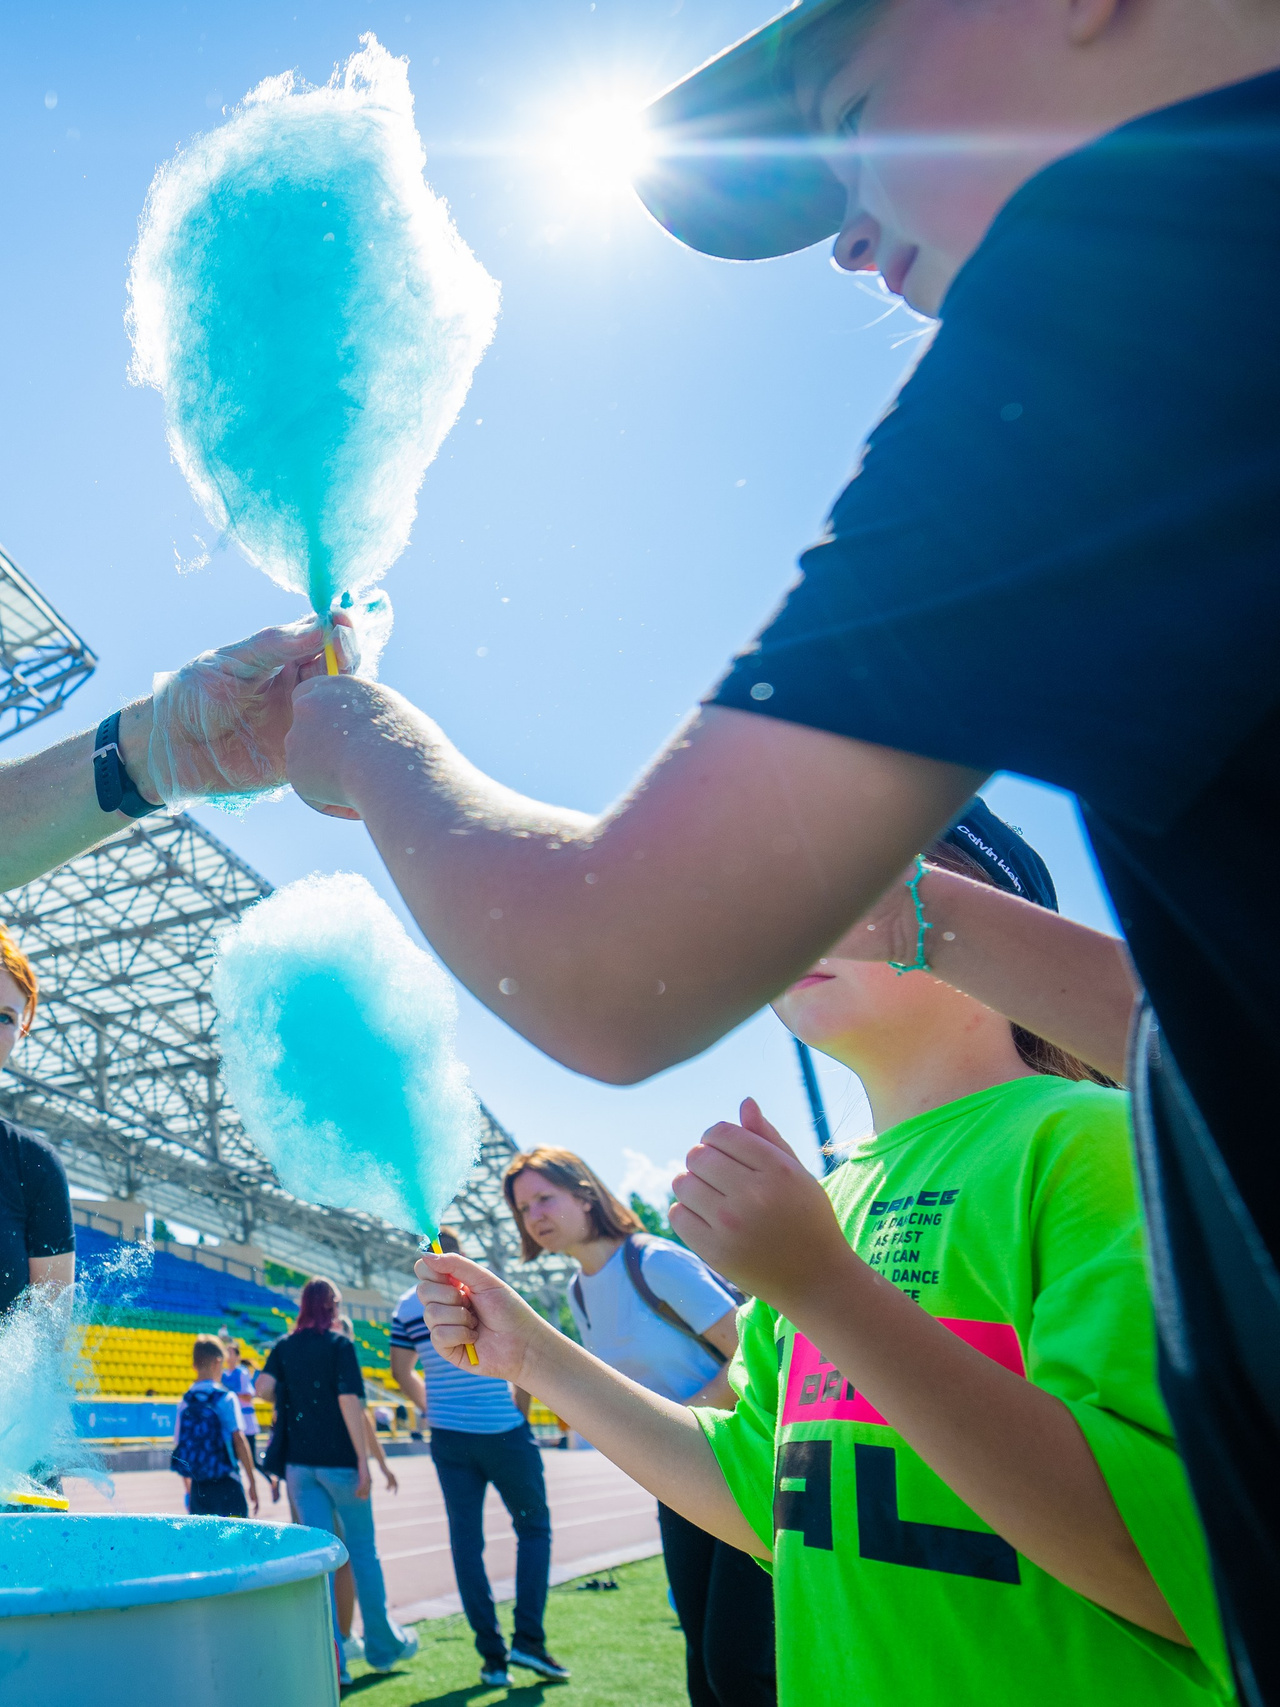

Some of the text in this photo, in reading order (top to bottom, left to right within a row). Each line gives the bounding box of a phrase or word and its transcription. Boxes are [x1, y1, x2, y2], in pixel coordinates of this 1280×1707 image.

[956, 825, 998, 861] Calvin
[891, 1230, 924, 1245] FAST
[892, 1249, 920, 1263] CAN
[891, 1269, 940, 1285] DANCE
